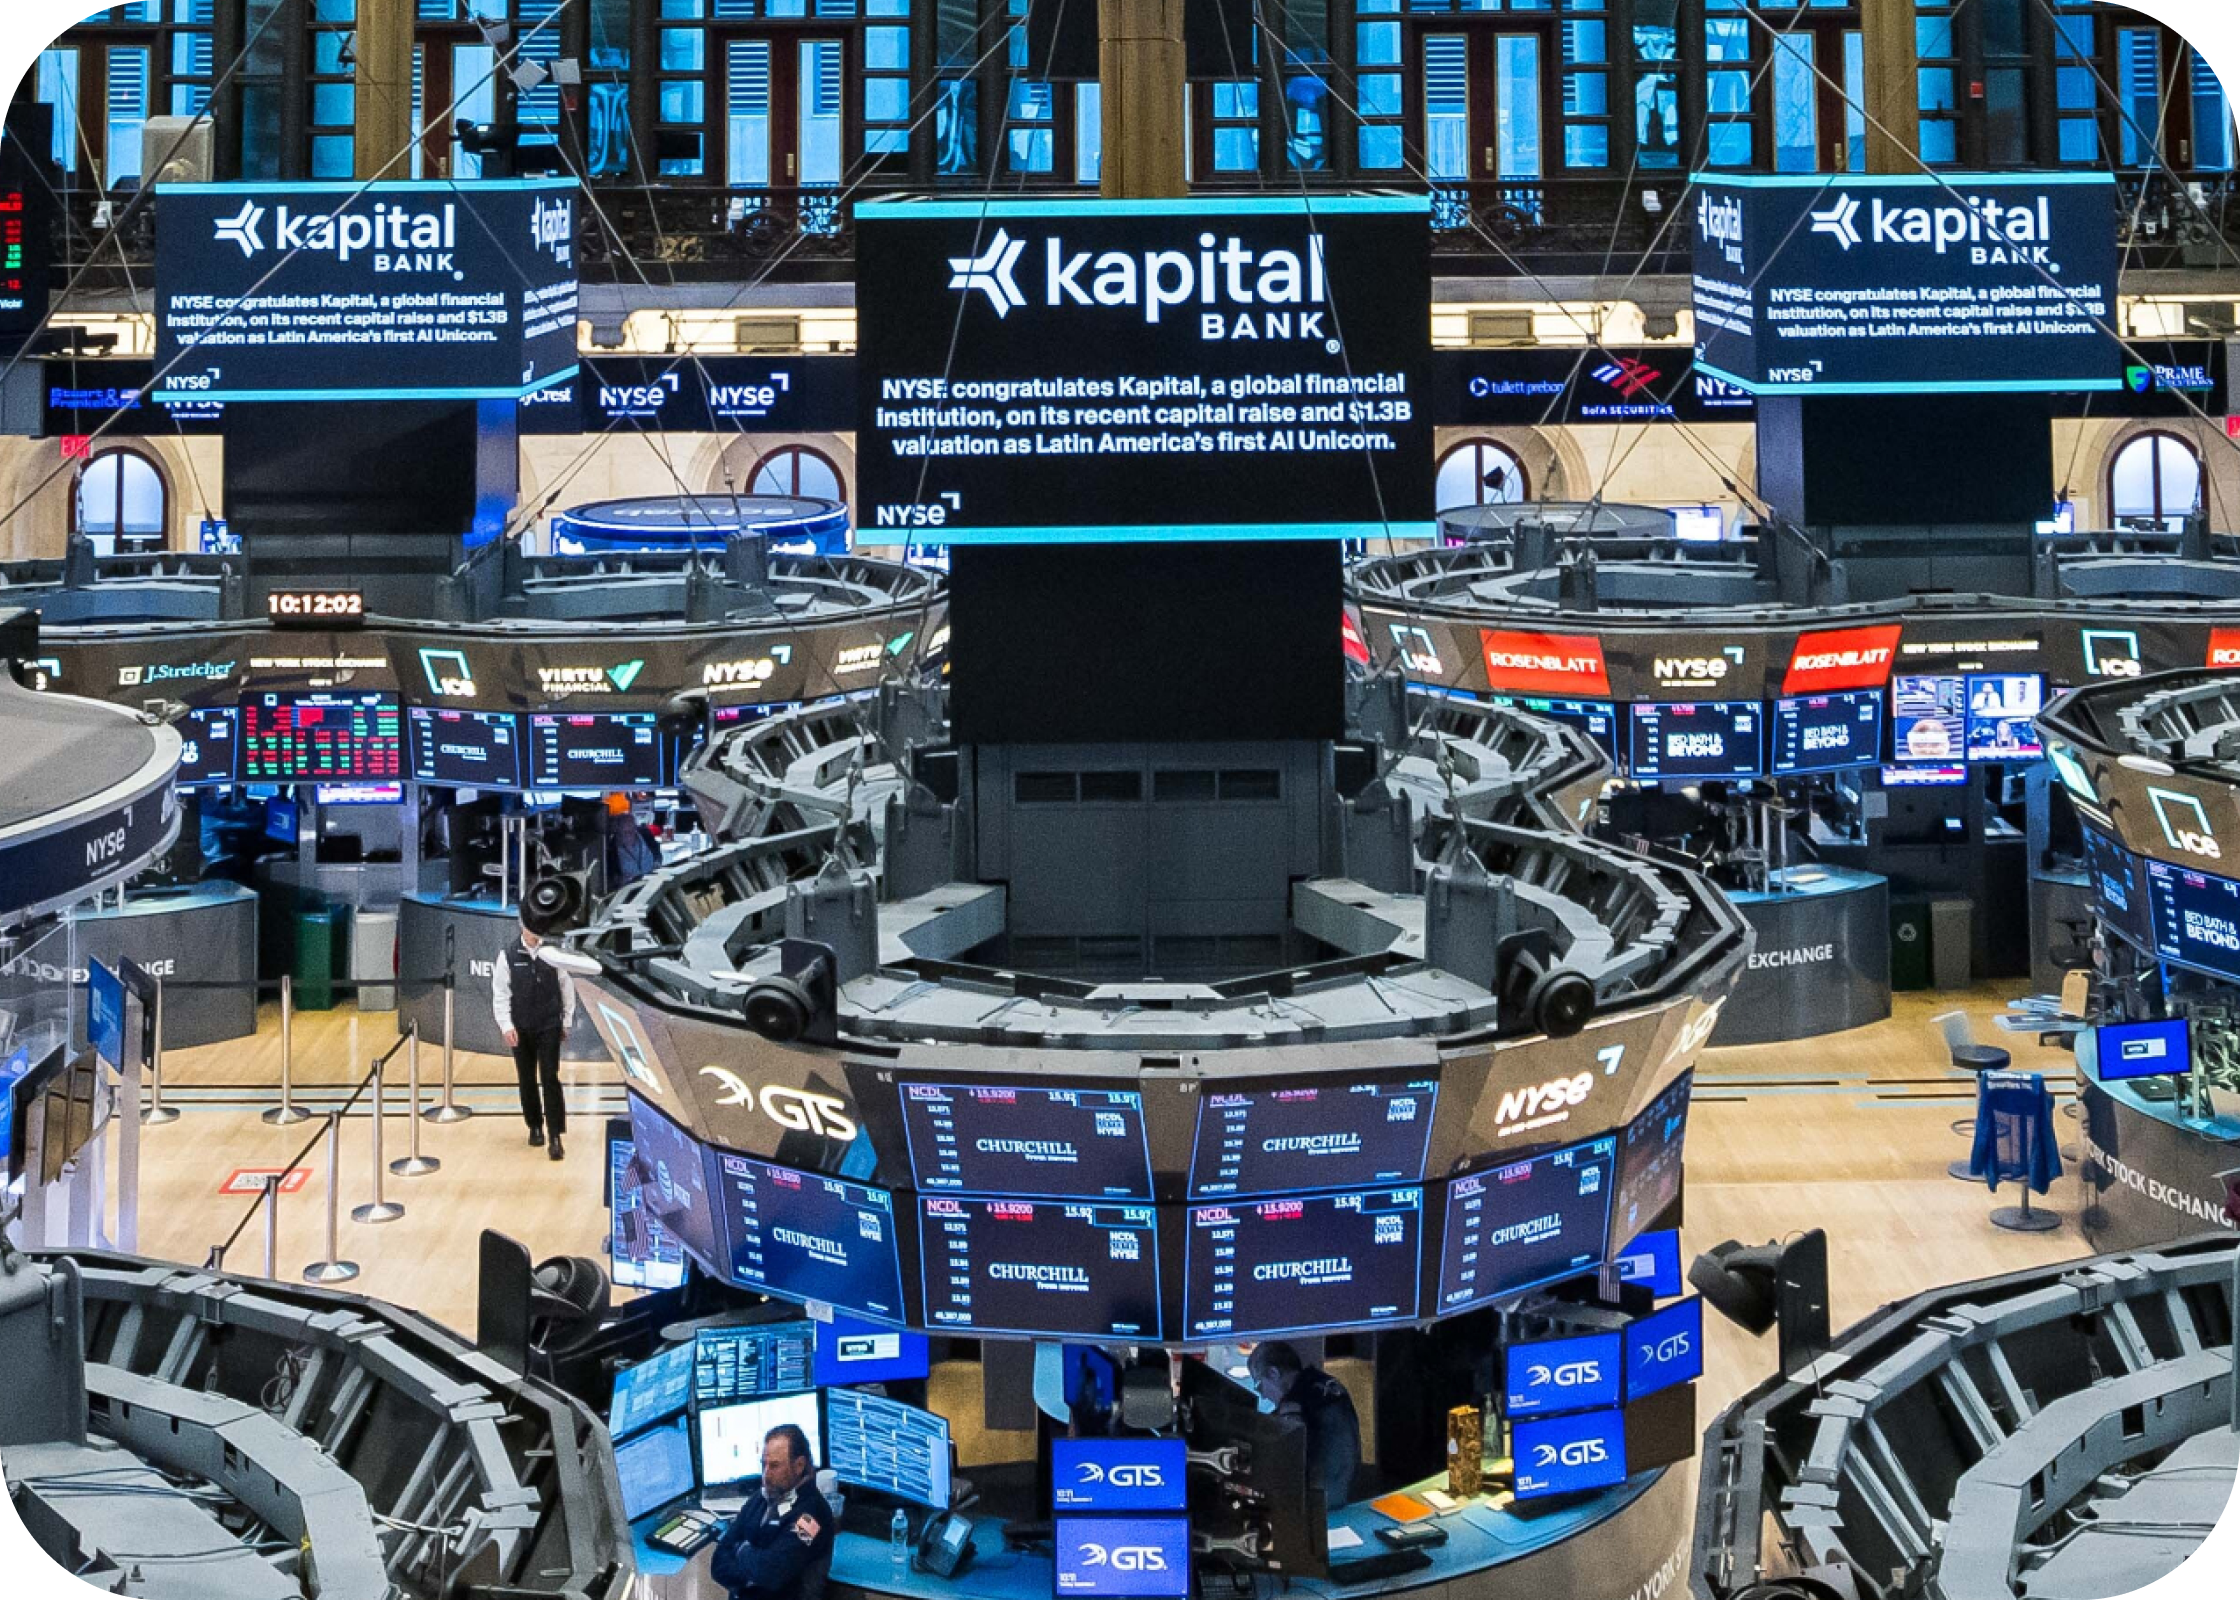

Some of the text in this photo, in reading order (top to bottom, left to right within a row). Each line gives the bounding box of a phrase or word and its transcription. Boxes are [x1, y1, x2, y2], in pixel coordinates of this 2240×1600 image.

[276, 203, 455, 261] kapital
[1872, 196, 2050, 253] kapital
[374, 254, 454, 271] BANK
[1047, 233, 1324, 323] kapital
[171, 292, 504, 311] NYSE congratulates Kapital, a global financial
[1770, 288, 1813, 302] NYSE
[1814, 287, 1918, 303] congratulates
[1919, 286, 1976, 302] Kapital,
[1978, 289, 1988, 299] a
[1990, 285, 2036, 302] global
[249, 316, 268, 326] on
[292, 313, 342, 325] recent
[343, 312, 395, 327] capital
[397, 312, 433, 323] raise
[437, 311, 465, 323] and
[1849, 308, 1869, 319] on
[1943, 304, 1994, 319] capital
[2035, 303, 2062, 317] and
[247, 332, 265, 343] as
[267, 330, 305, 343] Latin
[307, 329, 381, 342] America's
[383, 329, 414, 342] first
[1777, 324, 1846, 337] valuation
[1848, 326, 1866, 337] as
[1868, 323, 1905, 336] Latin
[1983, 322, 2014, 334] first
[882, 373, 1405, 402] NYSE congratulates Kapital, a global financial
[1696, 377, 1751, 396] NYS
[876, 401, 1412, 430] institution, on its recent capital raise and $1.3B
[892, 429, 1396, 455] valuation as Latin America's first AI Unicorn.
[268, 594, 362, 613] 10:12:02
[1490, 652, 1598, 672] ROSENBLATT
[1794, 648, 1890, 671] ROSENBLATT
[1748, 944, 1833, 969] EXCHANGE
[976, 1138, 1077, 1155] CHURCHILL
[1262, 1133, 1362, 1152] CHURCHILL
[2106, 1154, 2146, 1194] STOCK
[2149, 1179, 2236, 1230] EXCHANG
[927, 1199, 962, 1212] NCDL
[1197, 1207, 1232, 1222] NCDL
[1491, 1213, 1562, 1246] CHURCHILL
[773, 1227, 847, 1258] CHURCHILL
[989, 1263, 1089, 1282] CHURCHILL
[1253, 1257, 1353, 1281] CHURCHILL
[1657, 1331, 1690, 1363] GTS
